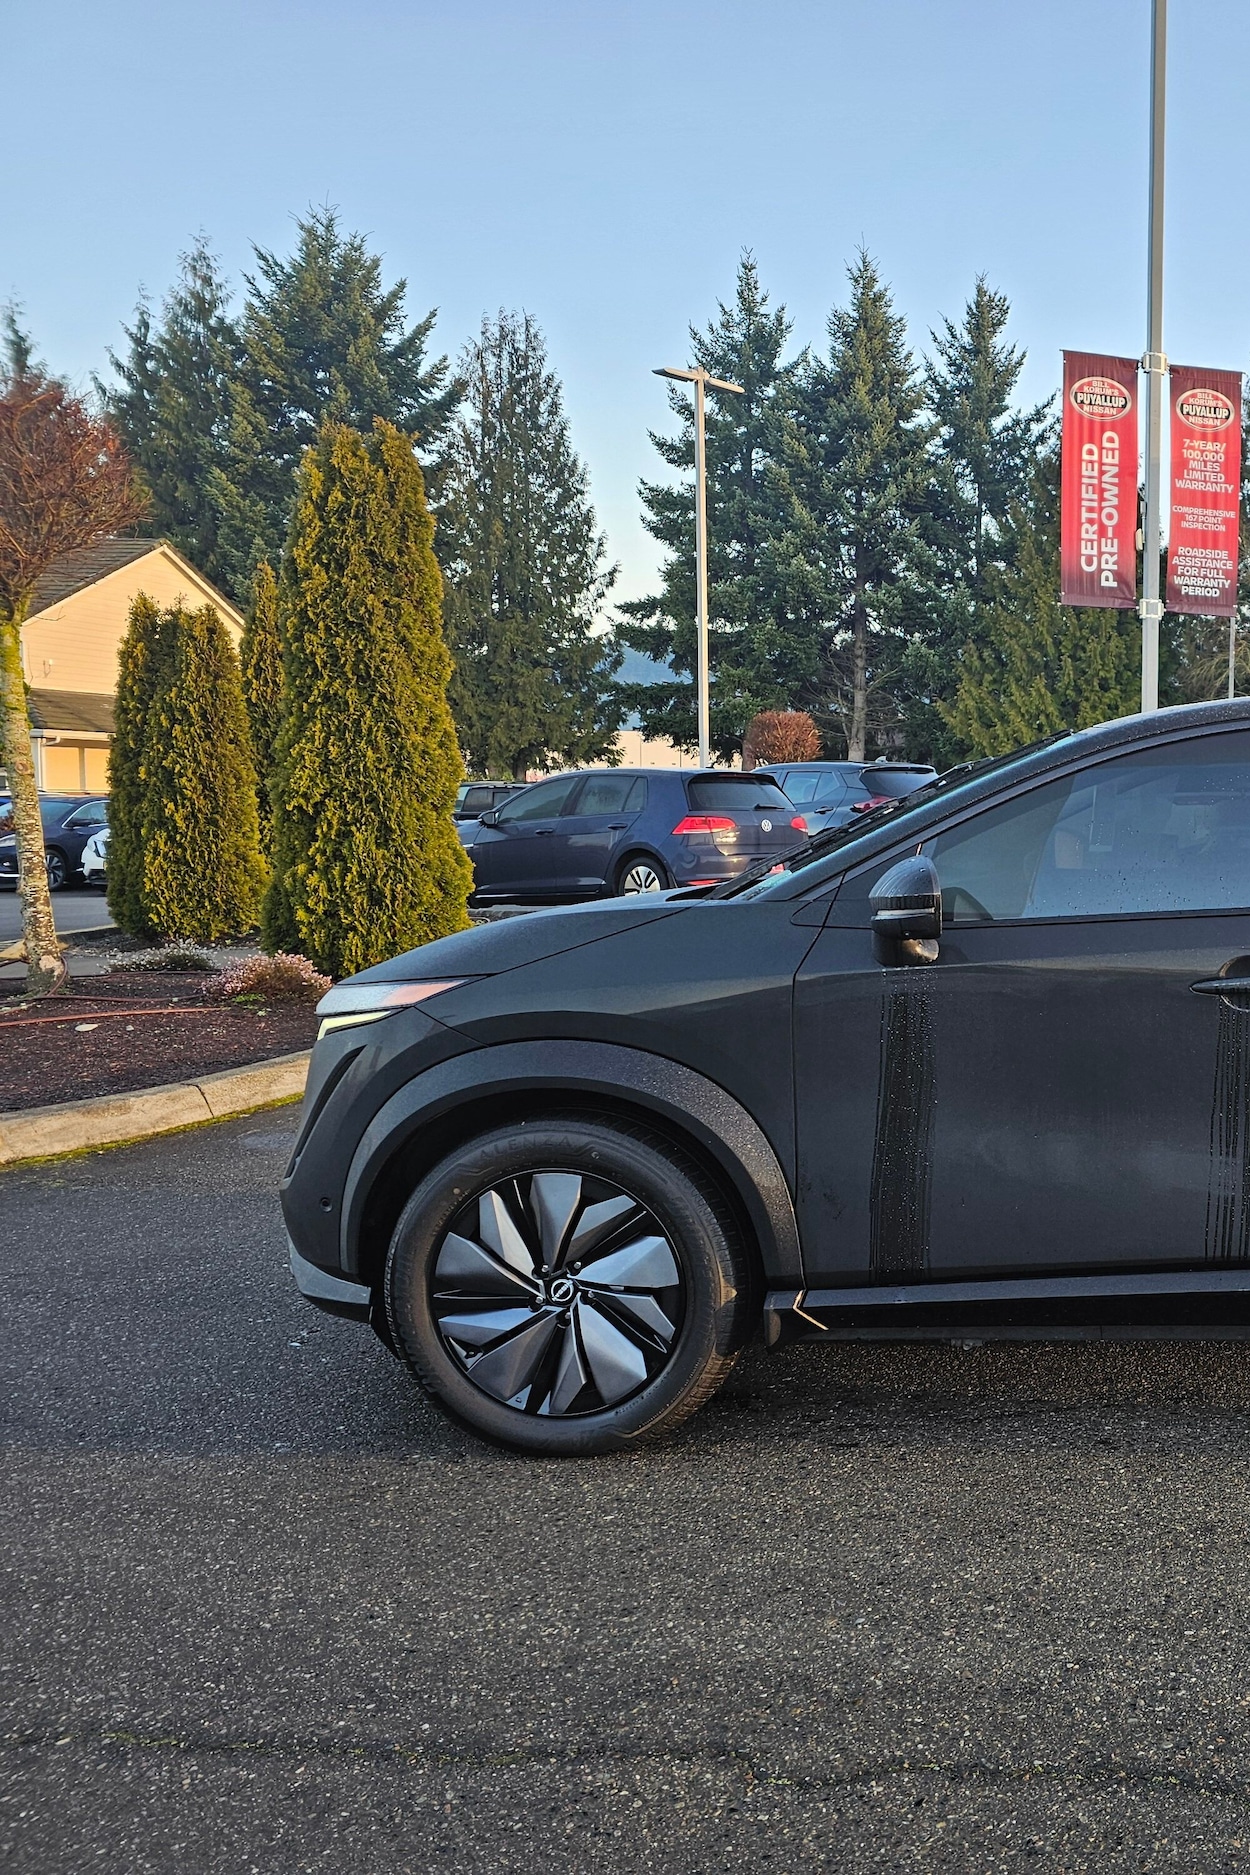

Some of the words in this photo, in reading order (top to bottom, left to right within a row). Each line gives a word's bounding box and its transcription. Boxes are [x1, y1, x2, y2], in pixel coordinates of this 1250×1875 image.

[1077, 393, 1125, 408] PUYALLUP
[1083, 405, 1117, 415] NISSAN
[1182, 404, 1229, 419] PUYALLUP
[1189, 416, 1221, 426] NISSAN
[1183, 439, 1227, 452] 7-YEAR/
[1182, 449, 1225, 462] 100,000
[1189, 460, 1220, 472] MILES
[1184, 469, 1225, 482] LIMITED
[1175, 479, 1234, 493] WARRANTY
[1080, 443, 1099, 572] CERTIFIED
[1101, 430, 1120, 587] PRE-OWNED
[1172, 505, 1236, 519] COMPREHENSIVE
[1199, 514, 1223, 524] POINT
[1181, 520, 1226, 532] INSPECTION
[1178, 546, 1229, 560] ROADSIDE
[1172, 556, 1233, 570] ASSISTANCE
[1178, 566, 1199, 577] FOR
[1200, 567, 1226, 579] FULL
[1174, 575, 1231, 589] WARRANTY
[1181, 585, 1220, 598] PERIOD
